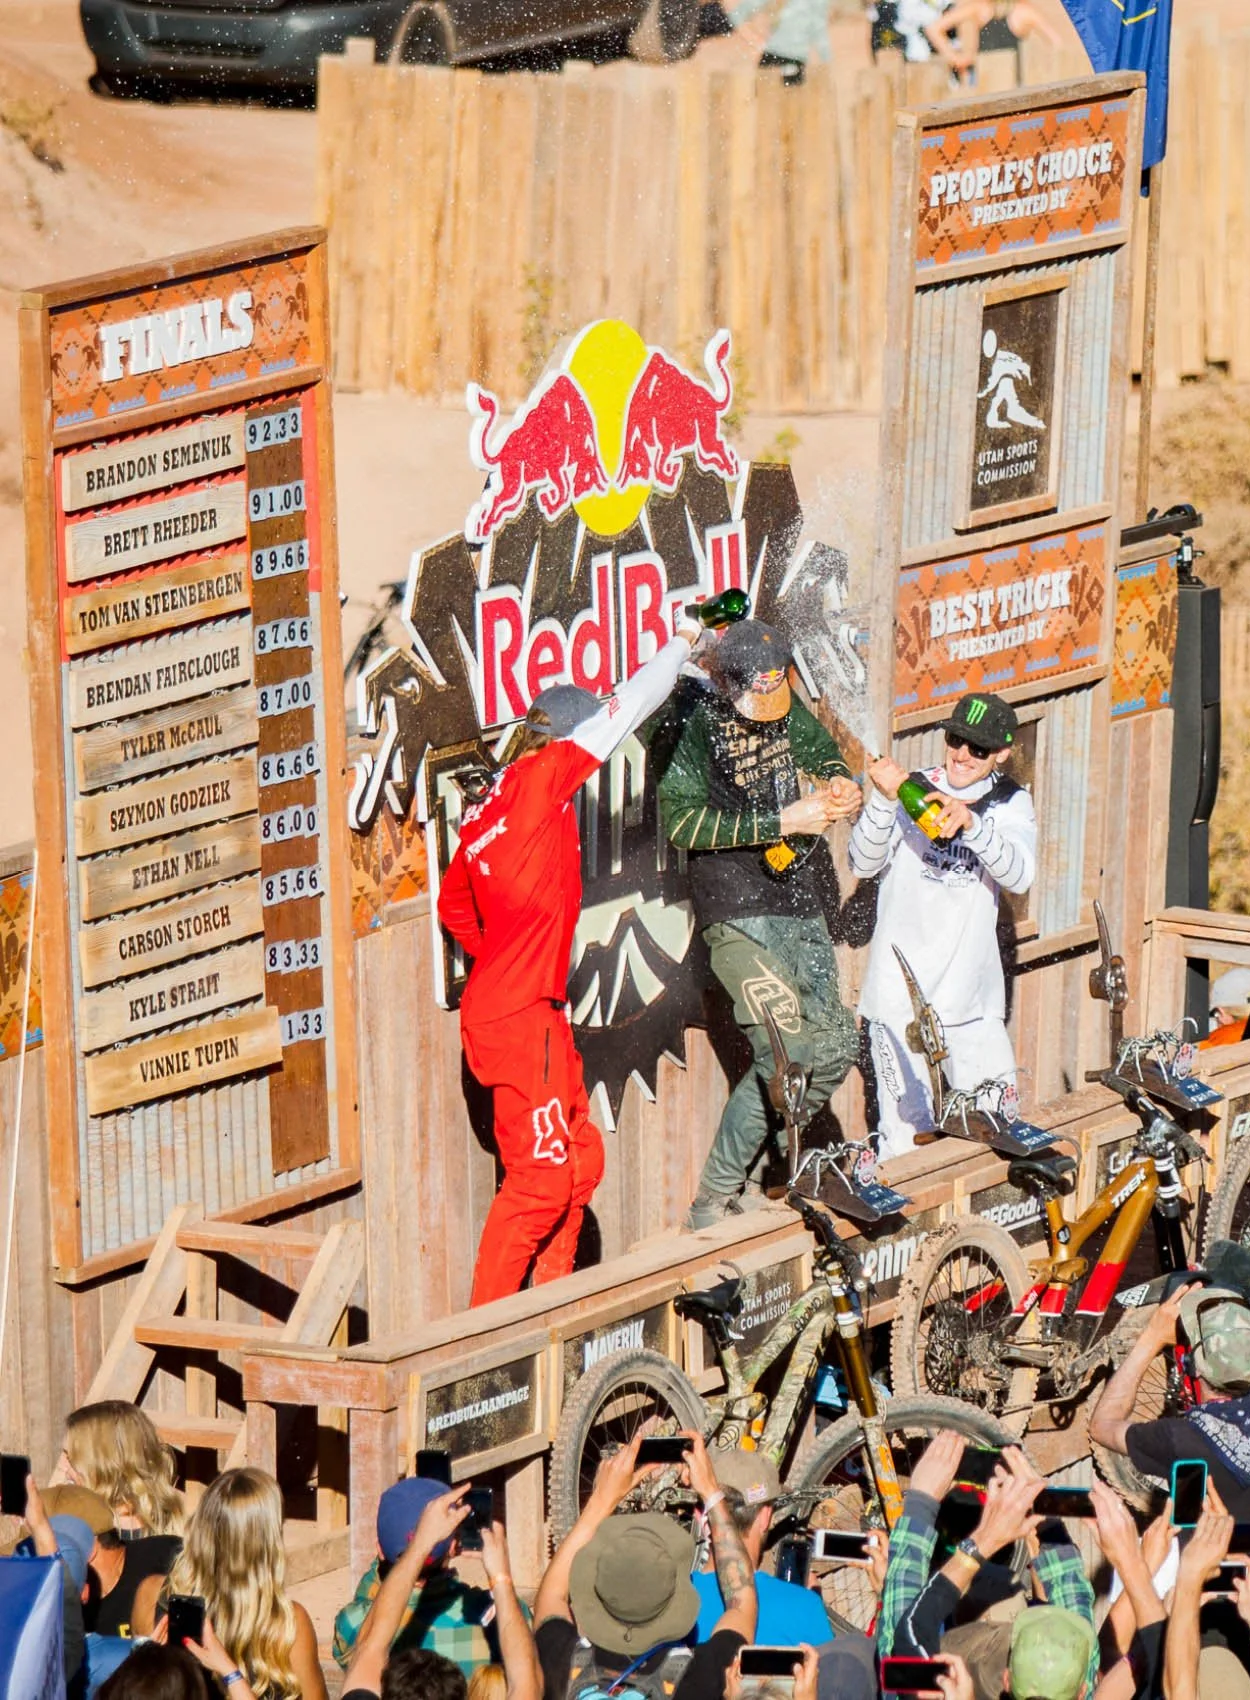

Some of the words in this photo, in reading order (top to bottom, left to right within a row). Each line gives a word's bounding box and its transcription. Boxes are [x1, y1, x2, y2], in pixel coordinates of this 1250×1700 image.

[929, 156, 1034, 207] PEOPLE'S
[1037, 142, 1113, 183] CHOICE
[972, 193, 1048, 227] PRESENTED
[1050, 187, 1071, 209] BY
[101, 292, 254, 383] FINALS
[86, 454, 157, 492] BRANDON
[163, 434, 232, 472] SEMENUK
[249, 412, 299, 445] 92.33
[977, 459, 1036, 486] COMMISSION
[978, 447, 1004, 466] UTAH
[1007, 439, 1038, 460] SPORTS
[104, 524, 148, 557] BRETT
[153, 508, 218, 544] RHEEDER
[252, 485, 302, 515] 91.00
[80, 604, 110, 633] TOM
[113, 598, 141, 625] VAN
[145, 571, 243, 618] STEENBERGEN
[255, 545, 305, 575] 89.66
[929, 587, 995, 639] BEST
[997, 570, 1073, 620] TRICK
[86, 671, 151, 708] BRENDAN
[156, 646, 240, 690] FAIRCLOUGH
[258, 620, 309, 650] 87.66
[481, 565, 615, 726] Red
[949, 624, 1025, 662] PRESENTED
[1026, 618, 1047, 641] BY
[121, 728, 166, 761] TYLER
[170, 714, 222, 749] McCAUL
[260, 681, 311, 712] 87.00
[110, 797, 165, 832] SZYMON
[170, 779, 231, 816] GODZIEK
[262, 746, 315, 780] 86.66
[132, 857, 179, 890] ETHAN
[185, 845, 220, 873] NELL
[262, 810, 315, 838] 86.00
[119, 923, 172, 960] CARSON
[177, 905, 231, 936] STORCH
[265, 869, 318, 900] 85.66
[129, 990, 165, 1021] KYLE
[170, 973, 221, 1003] STRAIT
[268, 943, 319, 967] 83.33
[140, 1050, 190, 1083] VINNIE
[195, 1036, 239, 1067] TUPIN
[287, 1014, 322, 1040] 1.33
[1111, 1168, 1147, 1208] TREK
[860, 1231, 929, 1284] enm
[740, 1294, 762, 1314] UTAH
[765, 1282, 791, 1305] SPORTS
[740, 1299, 791, 1331] COMMISSION
[584, 1319, 645, 1373] MAVERIK
